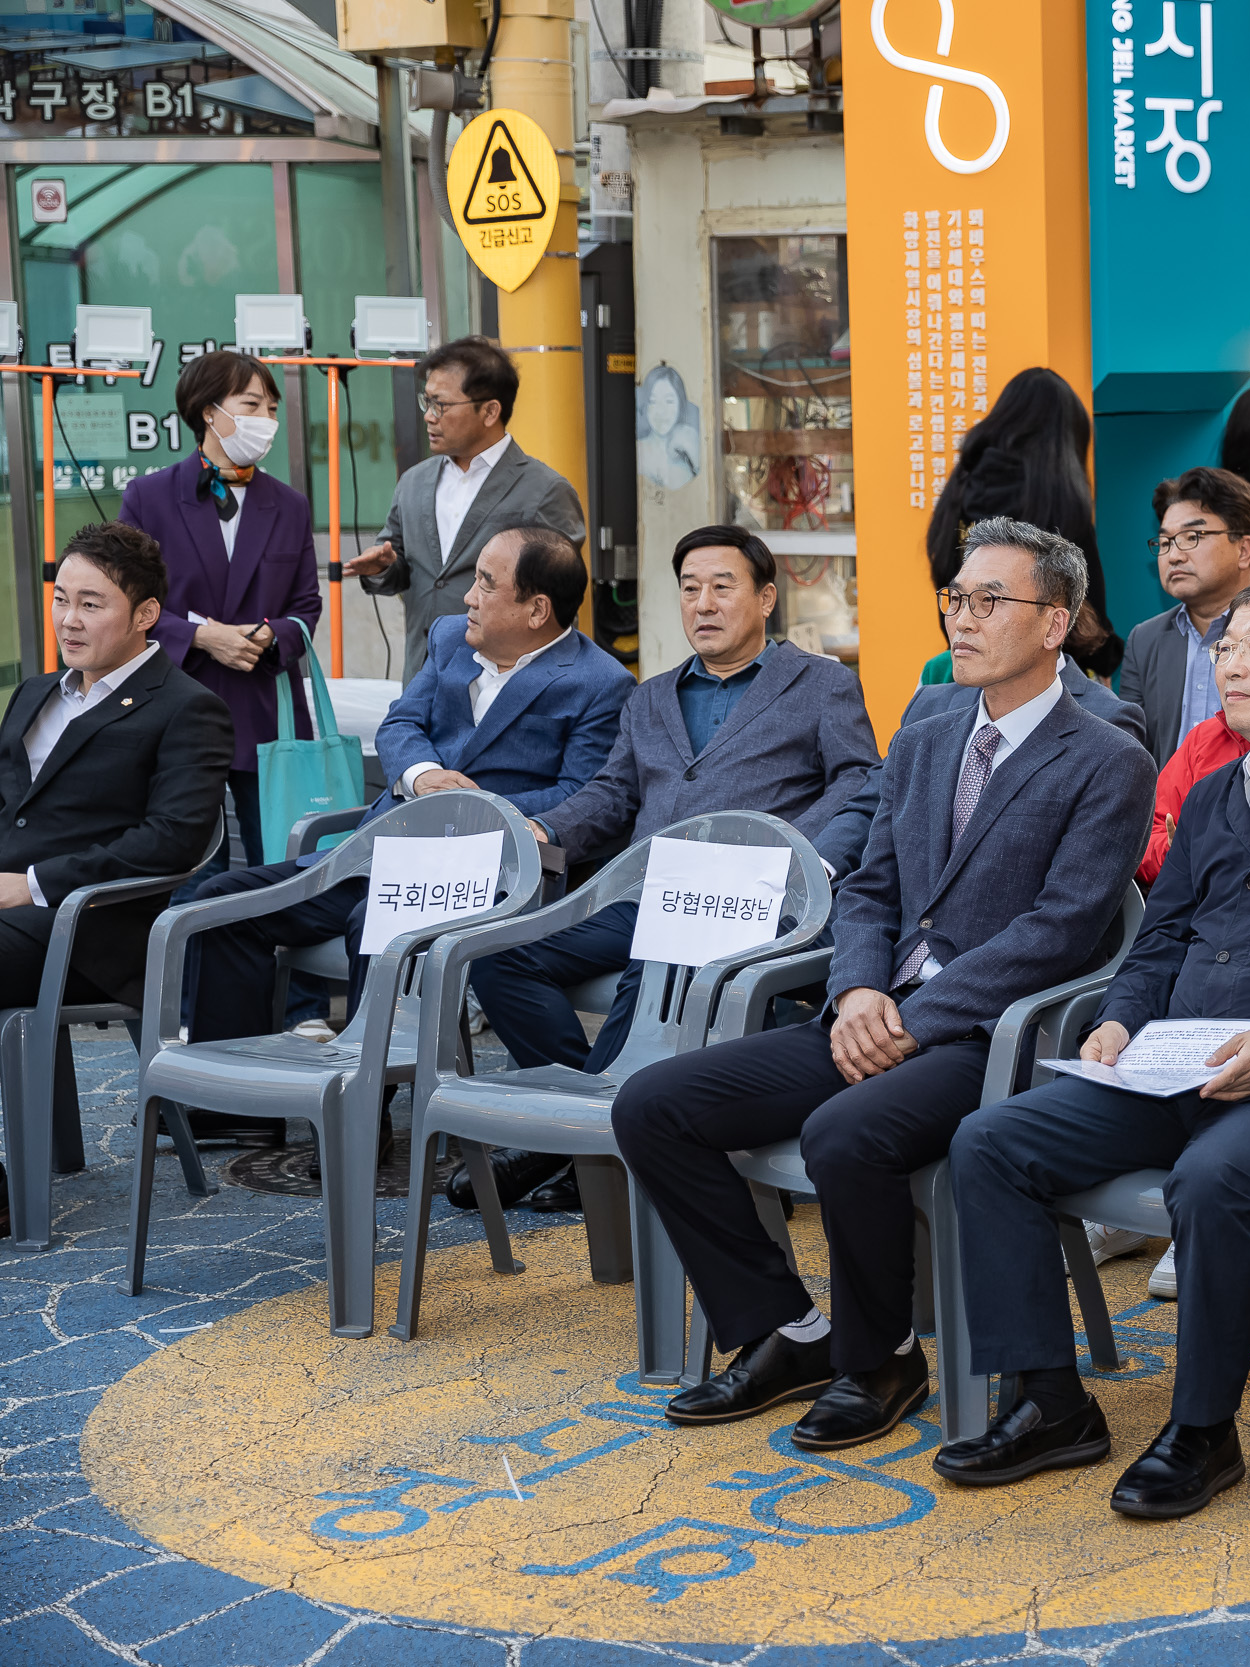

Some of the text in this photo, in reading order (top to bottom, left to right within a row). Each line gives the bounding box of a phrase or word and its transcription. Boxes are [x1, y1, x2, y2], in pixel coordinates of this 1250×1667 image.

[1112, 37, 1134, 84] JEIL
[145, 82, 194, 118] B1
[1145, 1, 1223, 194] 시장
[1113, 89, 1135, 189] MARKET
[486, 193, 522, 213] SOS
[479, 227, 533, 249] 긴급신고
[924, 209, 943, 268] 발전을
[946, 209, 965, 306] 기성세대와
[970, 312, 987, 351] 띠는
[902, 210, 927, 509] 화양제일시장의 심볼과 로고입니다
[971, 355, 989, 413] 전통과
[129, 413, 180, 450] B1
[377, 877, 490, 912] 국회의원님
[661, 888, 774, 921] 당협위원장님
